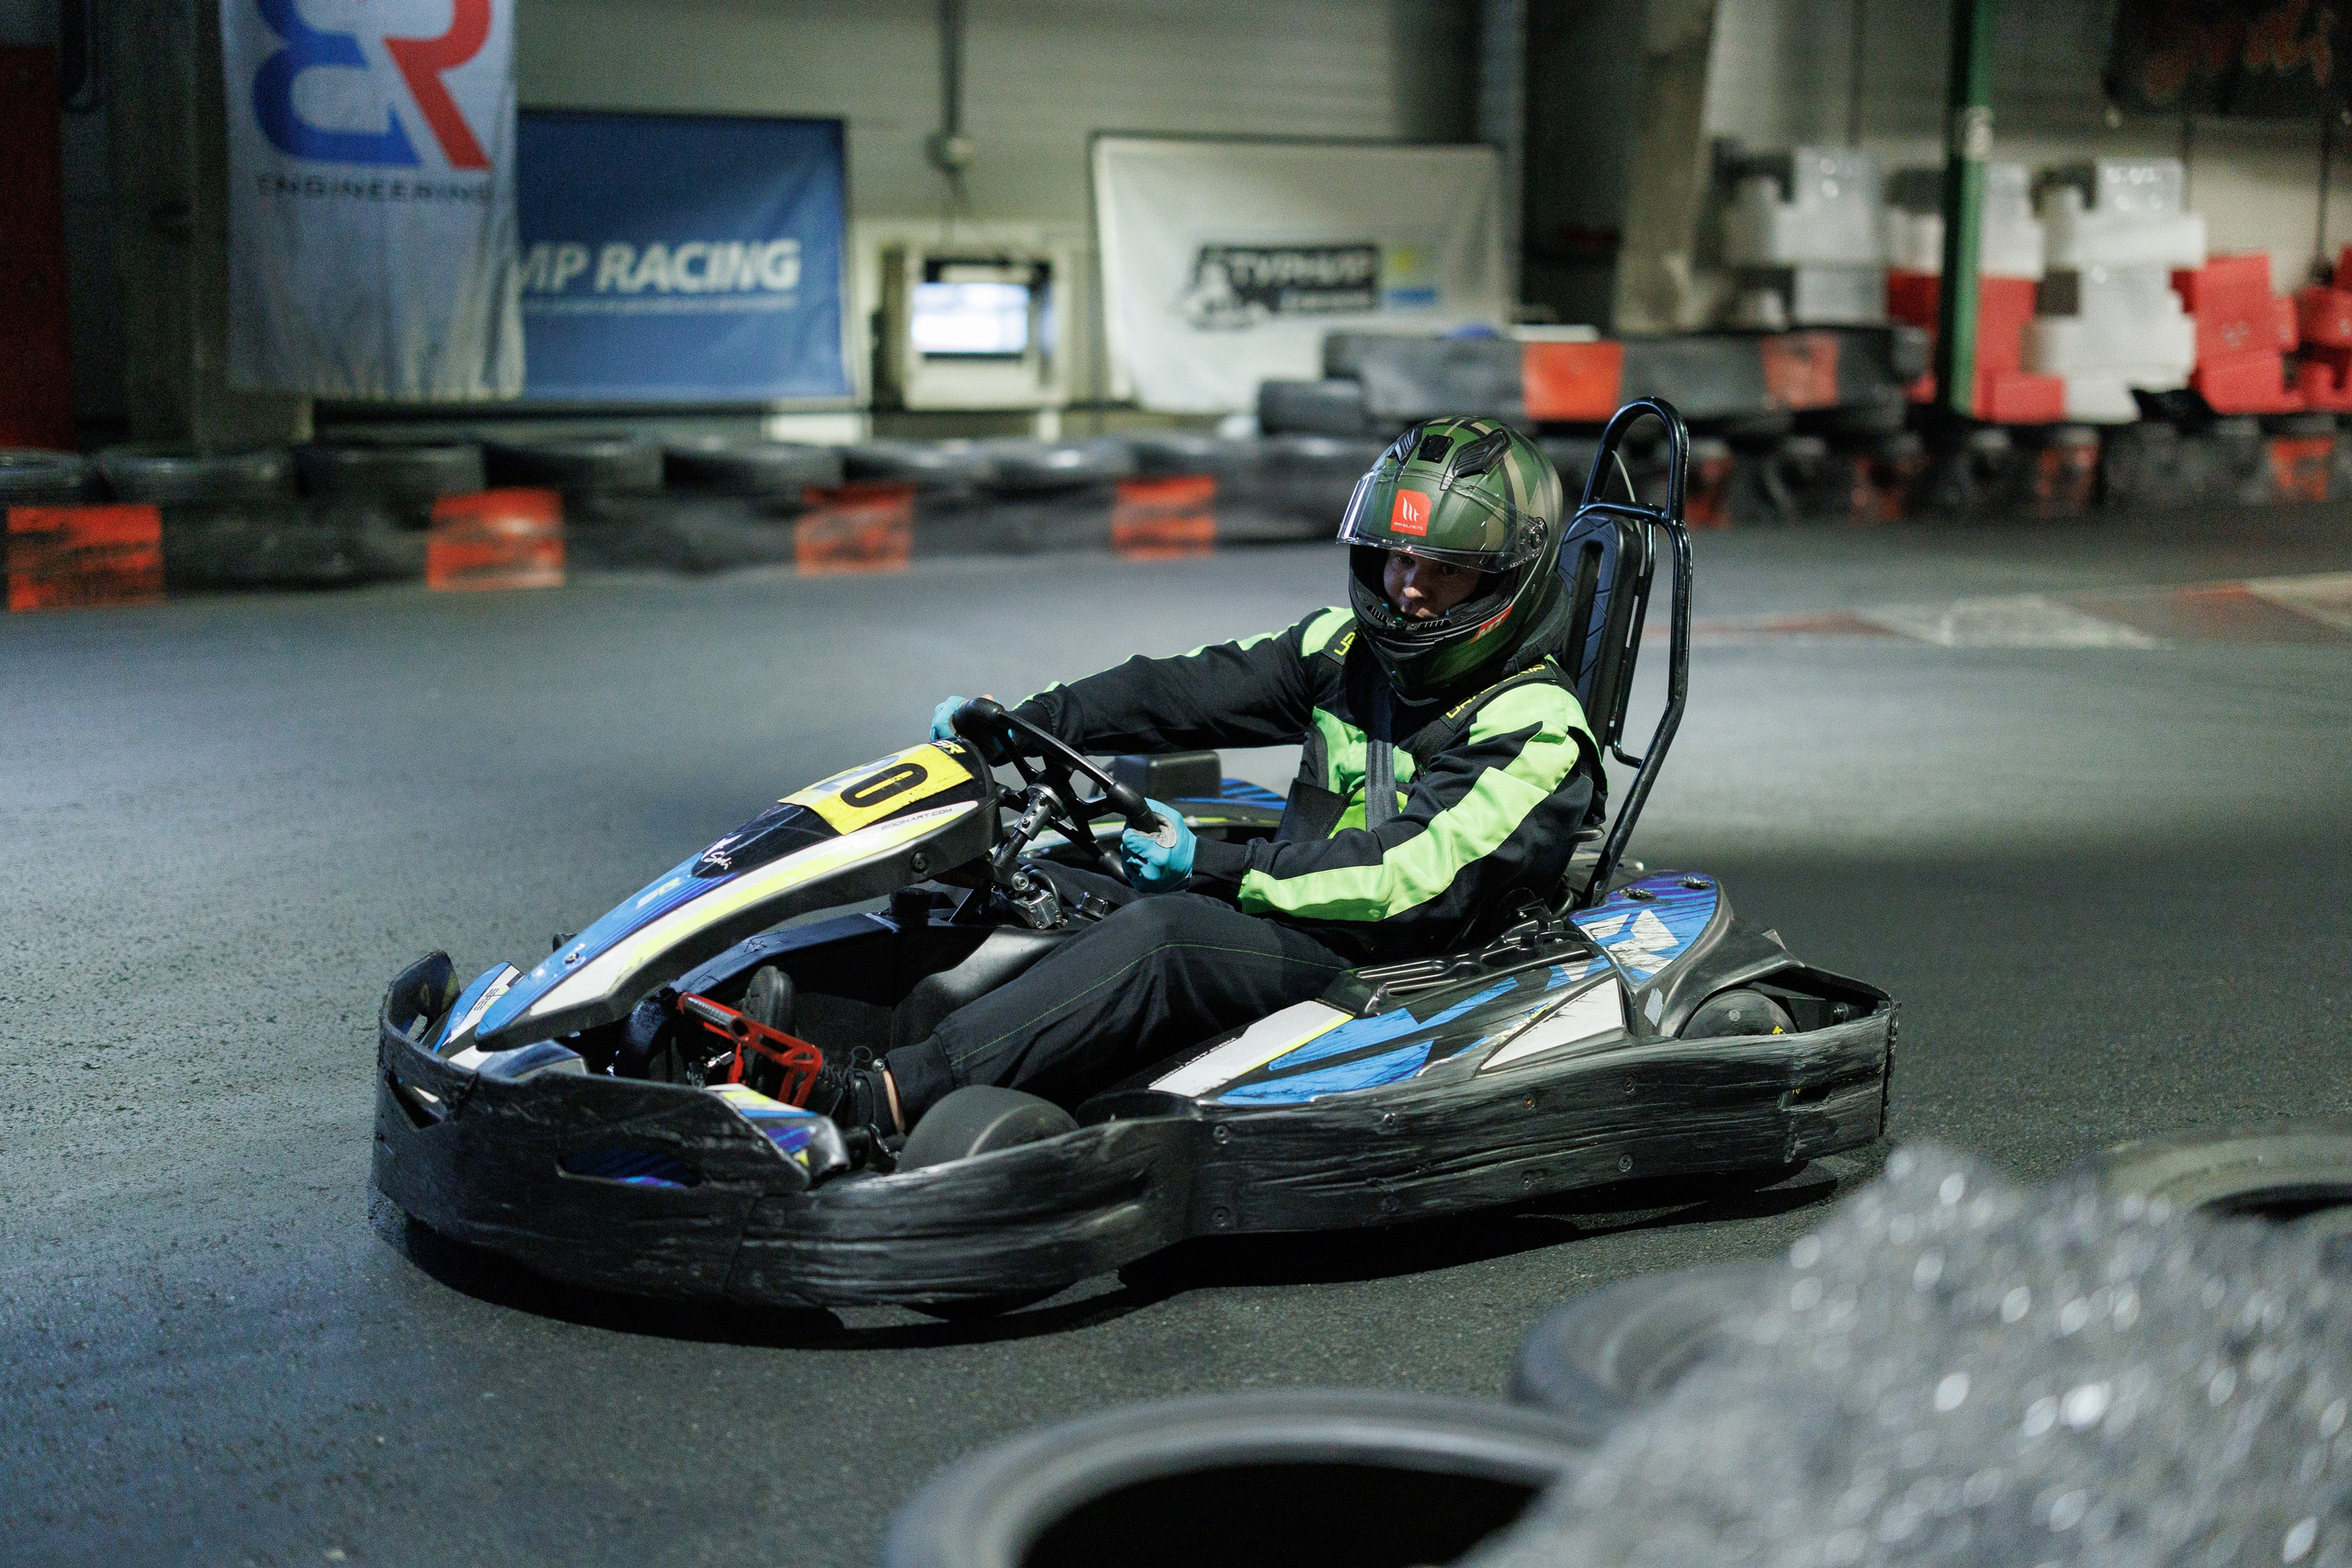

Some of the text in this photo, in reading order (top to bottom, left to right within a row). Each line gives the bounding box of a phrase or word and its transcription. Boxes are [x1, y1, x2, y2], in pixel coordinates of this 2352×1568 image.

[255, 173, 492, 204] ENGINEERING
[596, 236, 802, 294] RACING
[1476, 612, 1508, 641] MT
